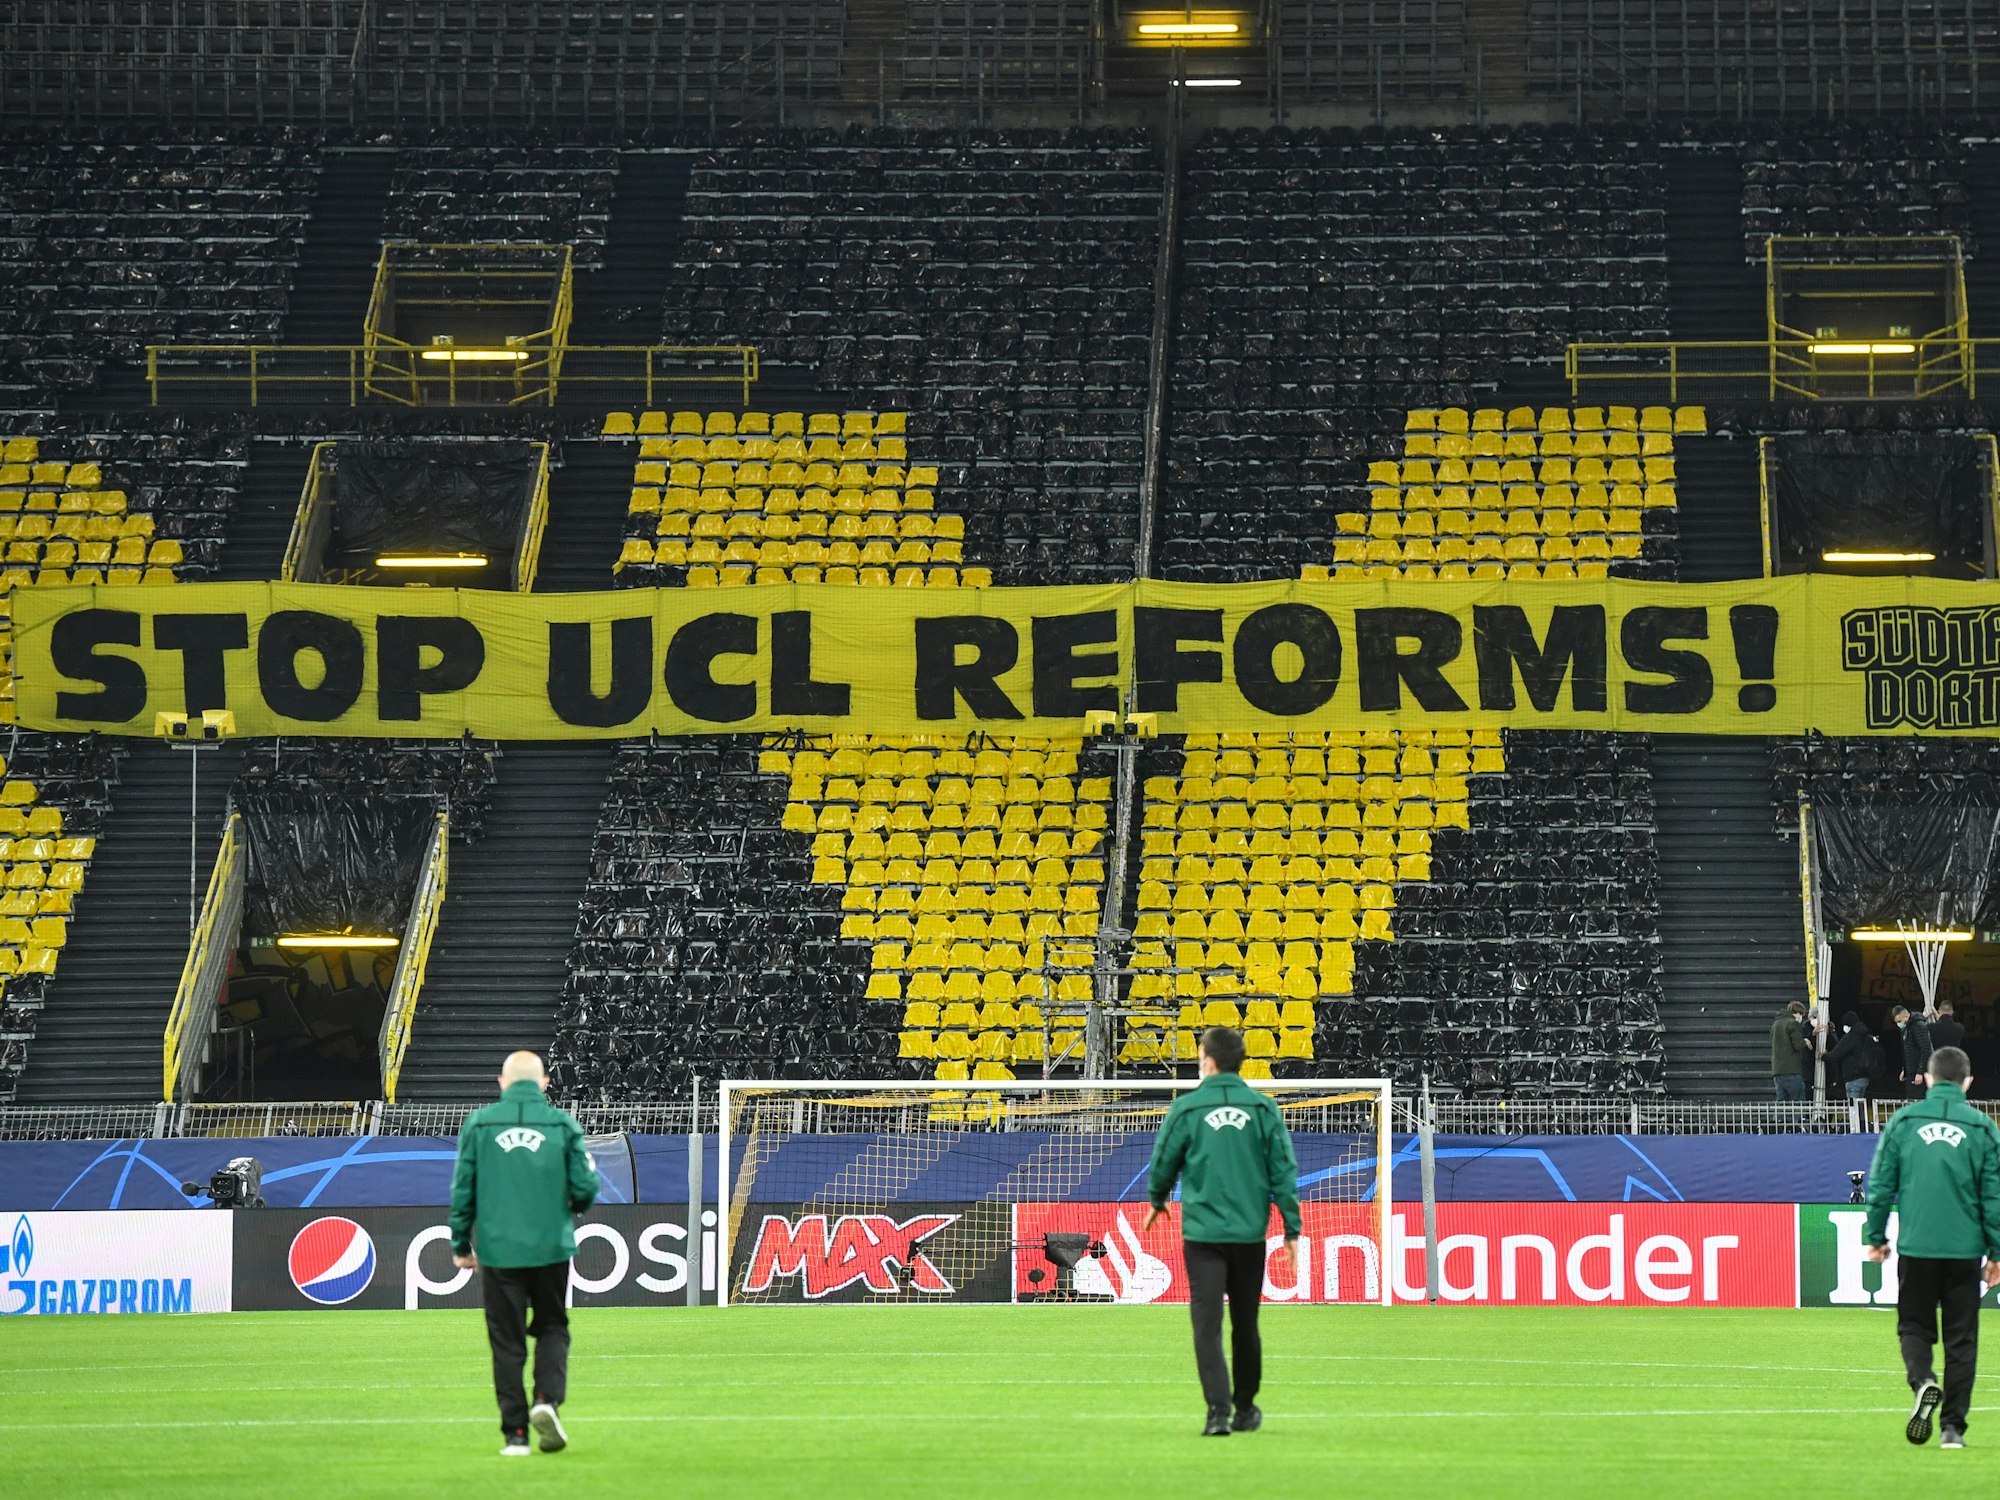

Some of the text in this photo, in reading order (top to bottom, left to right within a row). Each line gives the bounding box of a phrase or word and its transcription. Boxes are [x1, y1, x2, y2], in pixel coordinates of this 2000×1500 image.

[50, 602, 1779, 728] STOP UCL REFORMS!
[1204, 1106, 1251, 1131] UEFA
[1917, 1122, 1967, 1148] UEFA
[495, 1126, 546, 1153] UEFA
[404, 1209, 963, 1310] ppsi MAX
[1222, 1213, 1739, 1302] antander
[38, 1278, 192, 1314] GAZPROM
